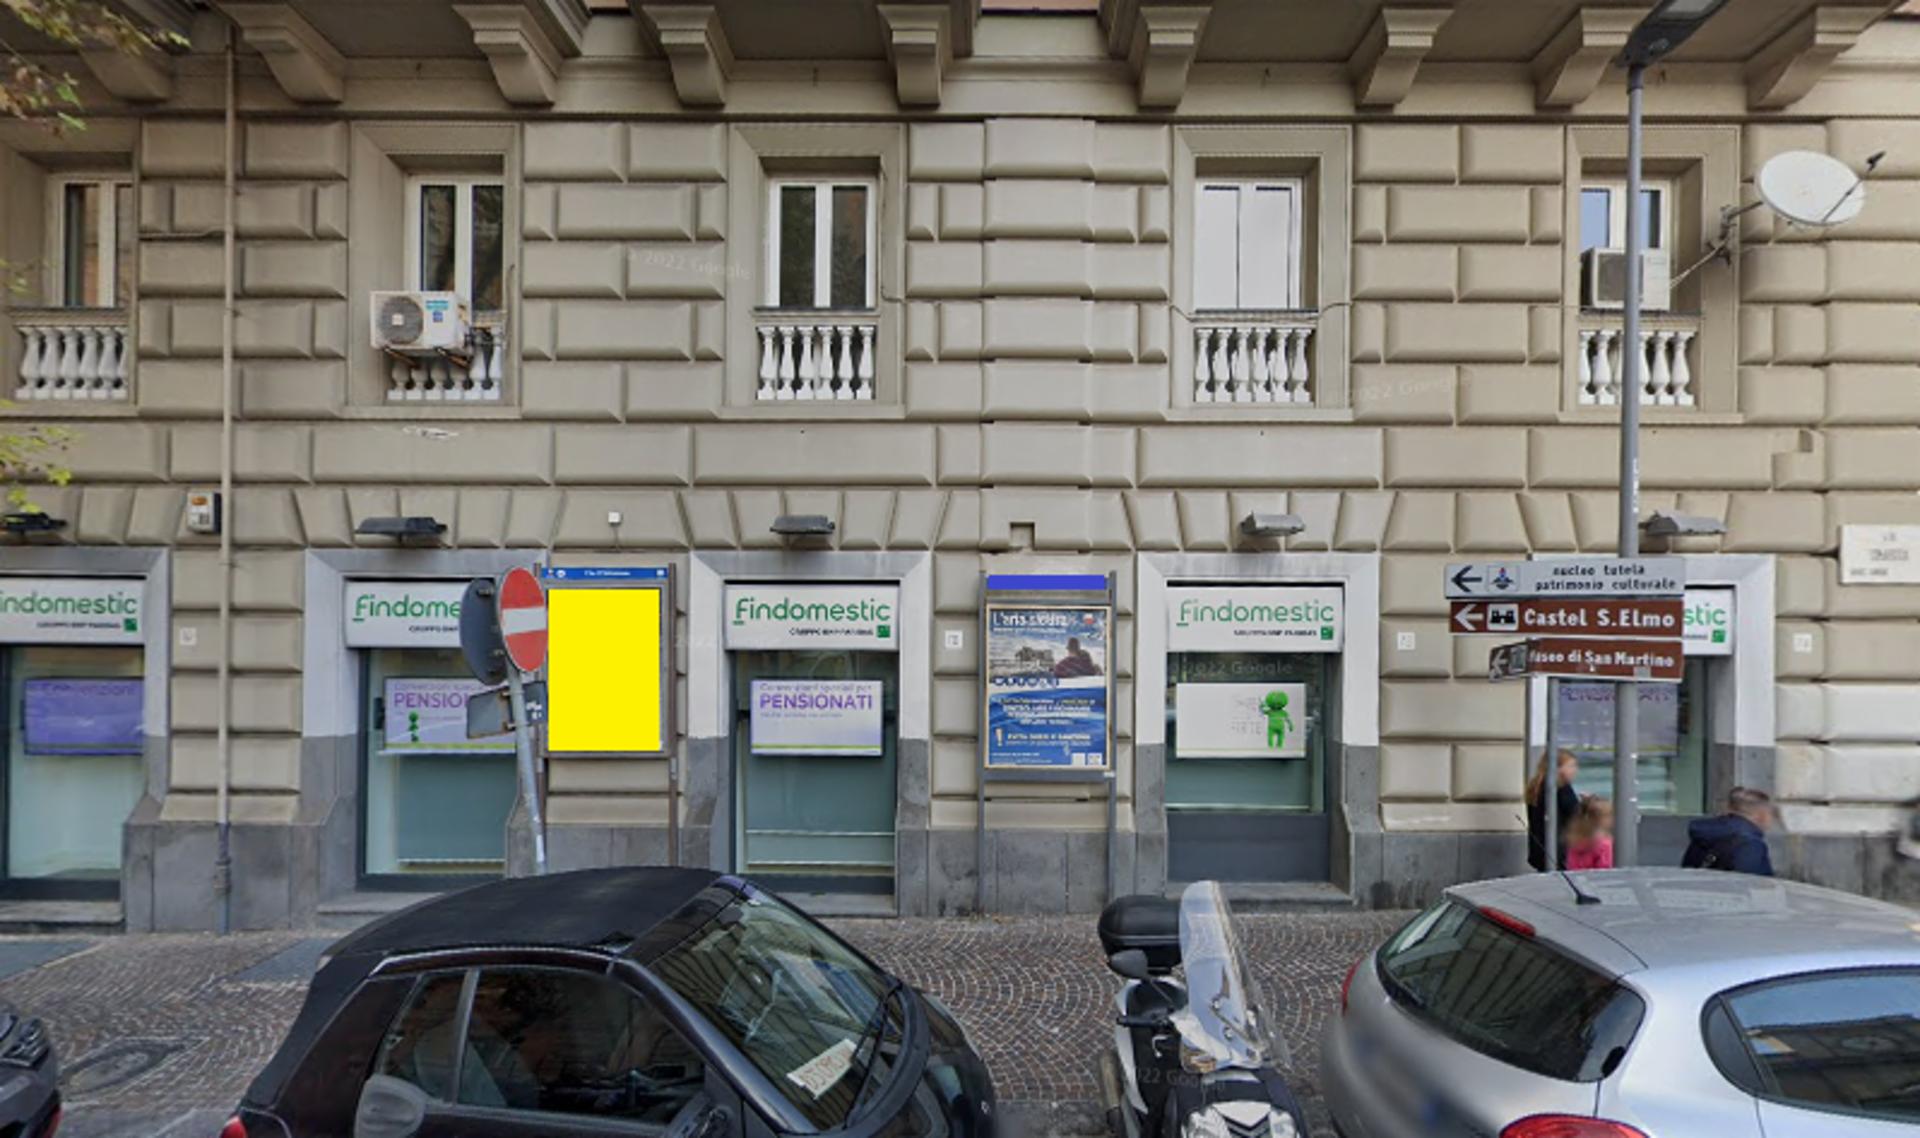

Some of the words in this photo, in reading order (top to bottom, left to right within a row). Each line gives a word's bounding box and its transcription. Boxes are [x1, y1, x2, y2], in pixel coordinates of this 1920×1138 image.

[1553, 565, 1596, 577] nucleo
[1604, 564, 1645, 575] tutela
[1535, 579, 1604, 592] patrimonio
[1612, 578, 1676, 591] culturale
[0, 590, 137, 615] indomestic
[352, 593, 462, 622] findome
[1523, 608, 1588, 627] Castel
[1568, 649, 1582, 663] di
[1585, 649, 1613, 665] San
[1614, 651, 1675, 668] Martino
[394, 692, 470, 708] PENSIO
[760, 693, 873, 710] PENSIONATI
